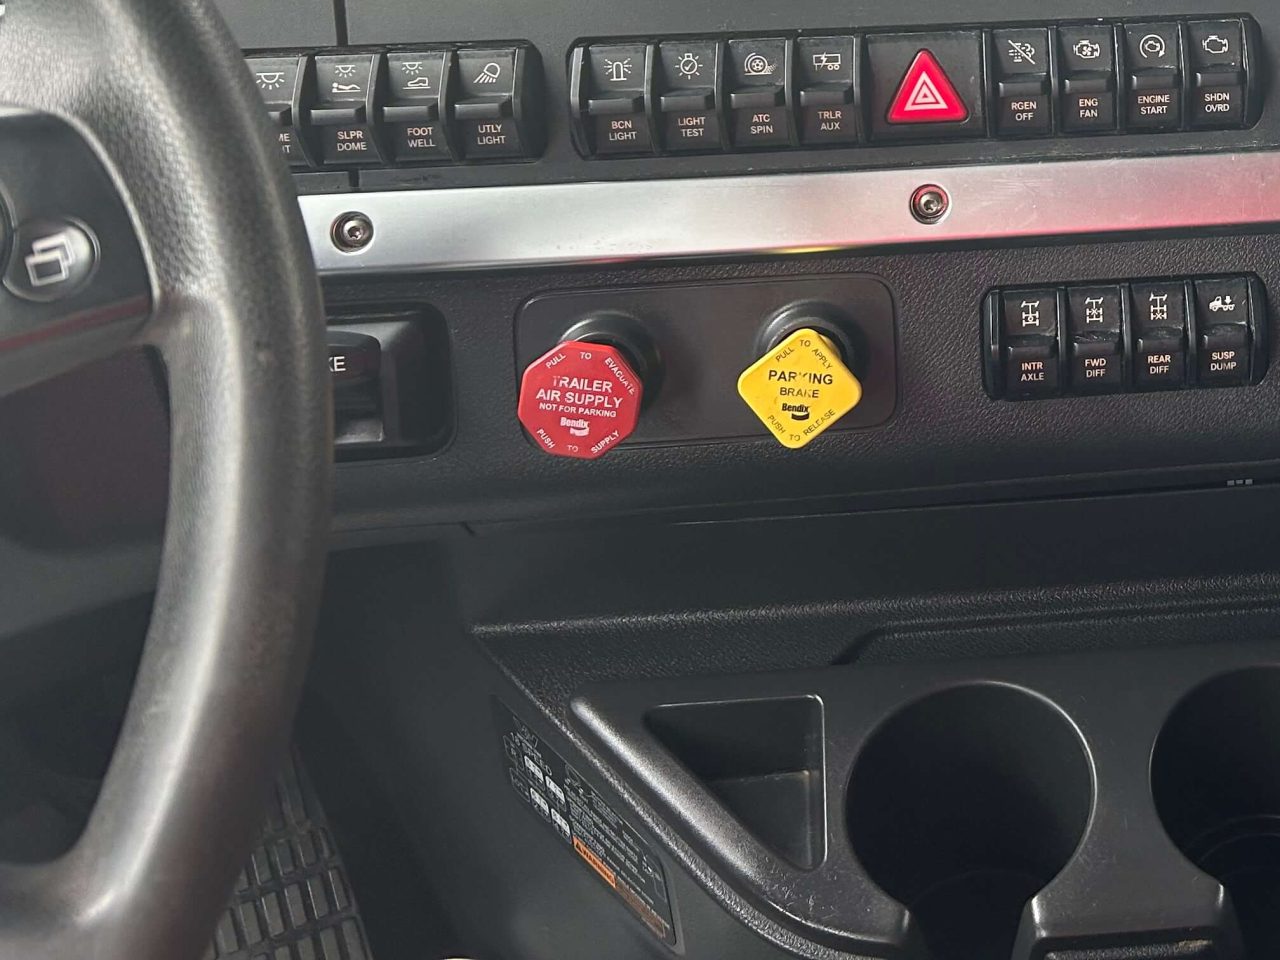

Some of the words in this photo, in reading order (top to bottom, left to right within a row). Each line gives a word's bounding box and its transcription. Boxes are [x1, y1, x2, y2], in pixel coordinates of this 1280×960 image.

[1137, 94, 1171, 105] ENGINE
[1204, 92, 1230, 103] SHDN
[1011, 100, 1037, 111] RGEN
[1078, 98, 1098, 108] ENG
[1205, 103, 1230, 113] OVRD
[817, 110, 842, 120] TRLR
[1079, 109, 1098, 118] FAN
[1140, 105, 1168, 115] START
[678, 116, 706, 127] LIGHT
[752, 113, 771, 123] ATC
[1015, 112, 1034, 121] OFF
[478, 124, 502, 134] UTLY
[611, 120, 632, 130] BCN
[750, 125, 773, 135] SPIN
[820, 121, 841, 131] AUX
[337, 130, 364, 141] SLPR
[407, 126, 434, 137] FOOT
[609, 131, 637, 141] LIGHT
[681, 127, 705, 137] TEST
[407, 138, 436, 148] WELL
[477, 135, 506, 145] LIGHT
[336, 141, 368, 152] DOME
[799, 339, 811, 347] TO
[775, 347, 795, 362] PULL
[812, 348, 833, 369] APPLY
[1147, 354, 1171, 364] REAR
[1211, 351, 1235, 362] SUSP
[1021, 361, 1043, 371] INTR
[1084, 357, 1107, 368] FWD
[1210, 361, 1237, 371] DUMP
[545, 353, 567, 368] PULL
[579, 351, 592, 360] TO
[604, 357, 635, 395] EVACUATE
[1085, 368, 1106, 378] DIFF
[1149, 364, 1170, 374] DIFF
[1020, 371, 1045, 381] AXLE
[552, 375, 613, 393] TRAILER
[779, 386, 820, 399] BRAKE
[535, 388, 561, 401] AIR
[564, 391, 624, 408] SUPPLY
[539, 402, 558, 411] NOT
[558, 405, 577, 413] FOR
[578, 407, 617, 418] PARKING
[781, 402, 809, 412] Bendix
[560, 417, 589, 429] Bendix
[768, 414, 786, 434] PUSH
[802, 408, 836, 436] RELEASE
[536, 428, 556, 449] PUSH
[567, 444, 579, 453] TO
[590, 430, 620, 454] SUPPLY
